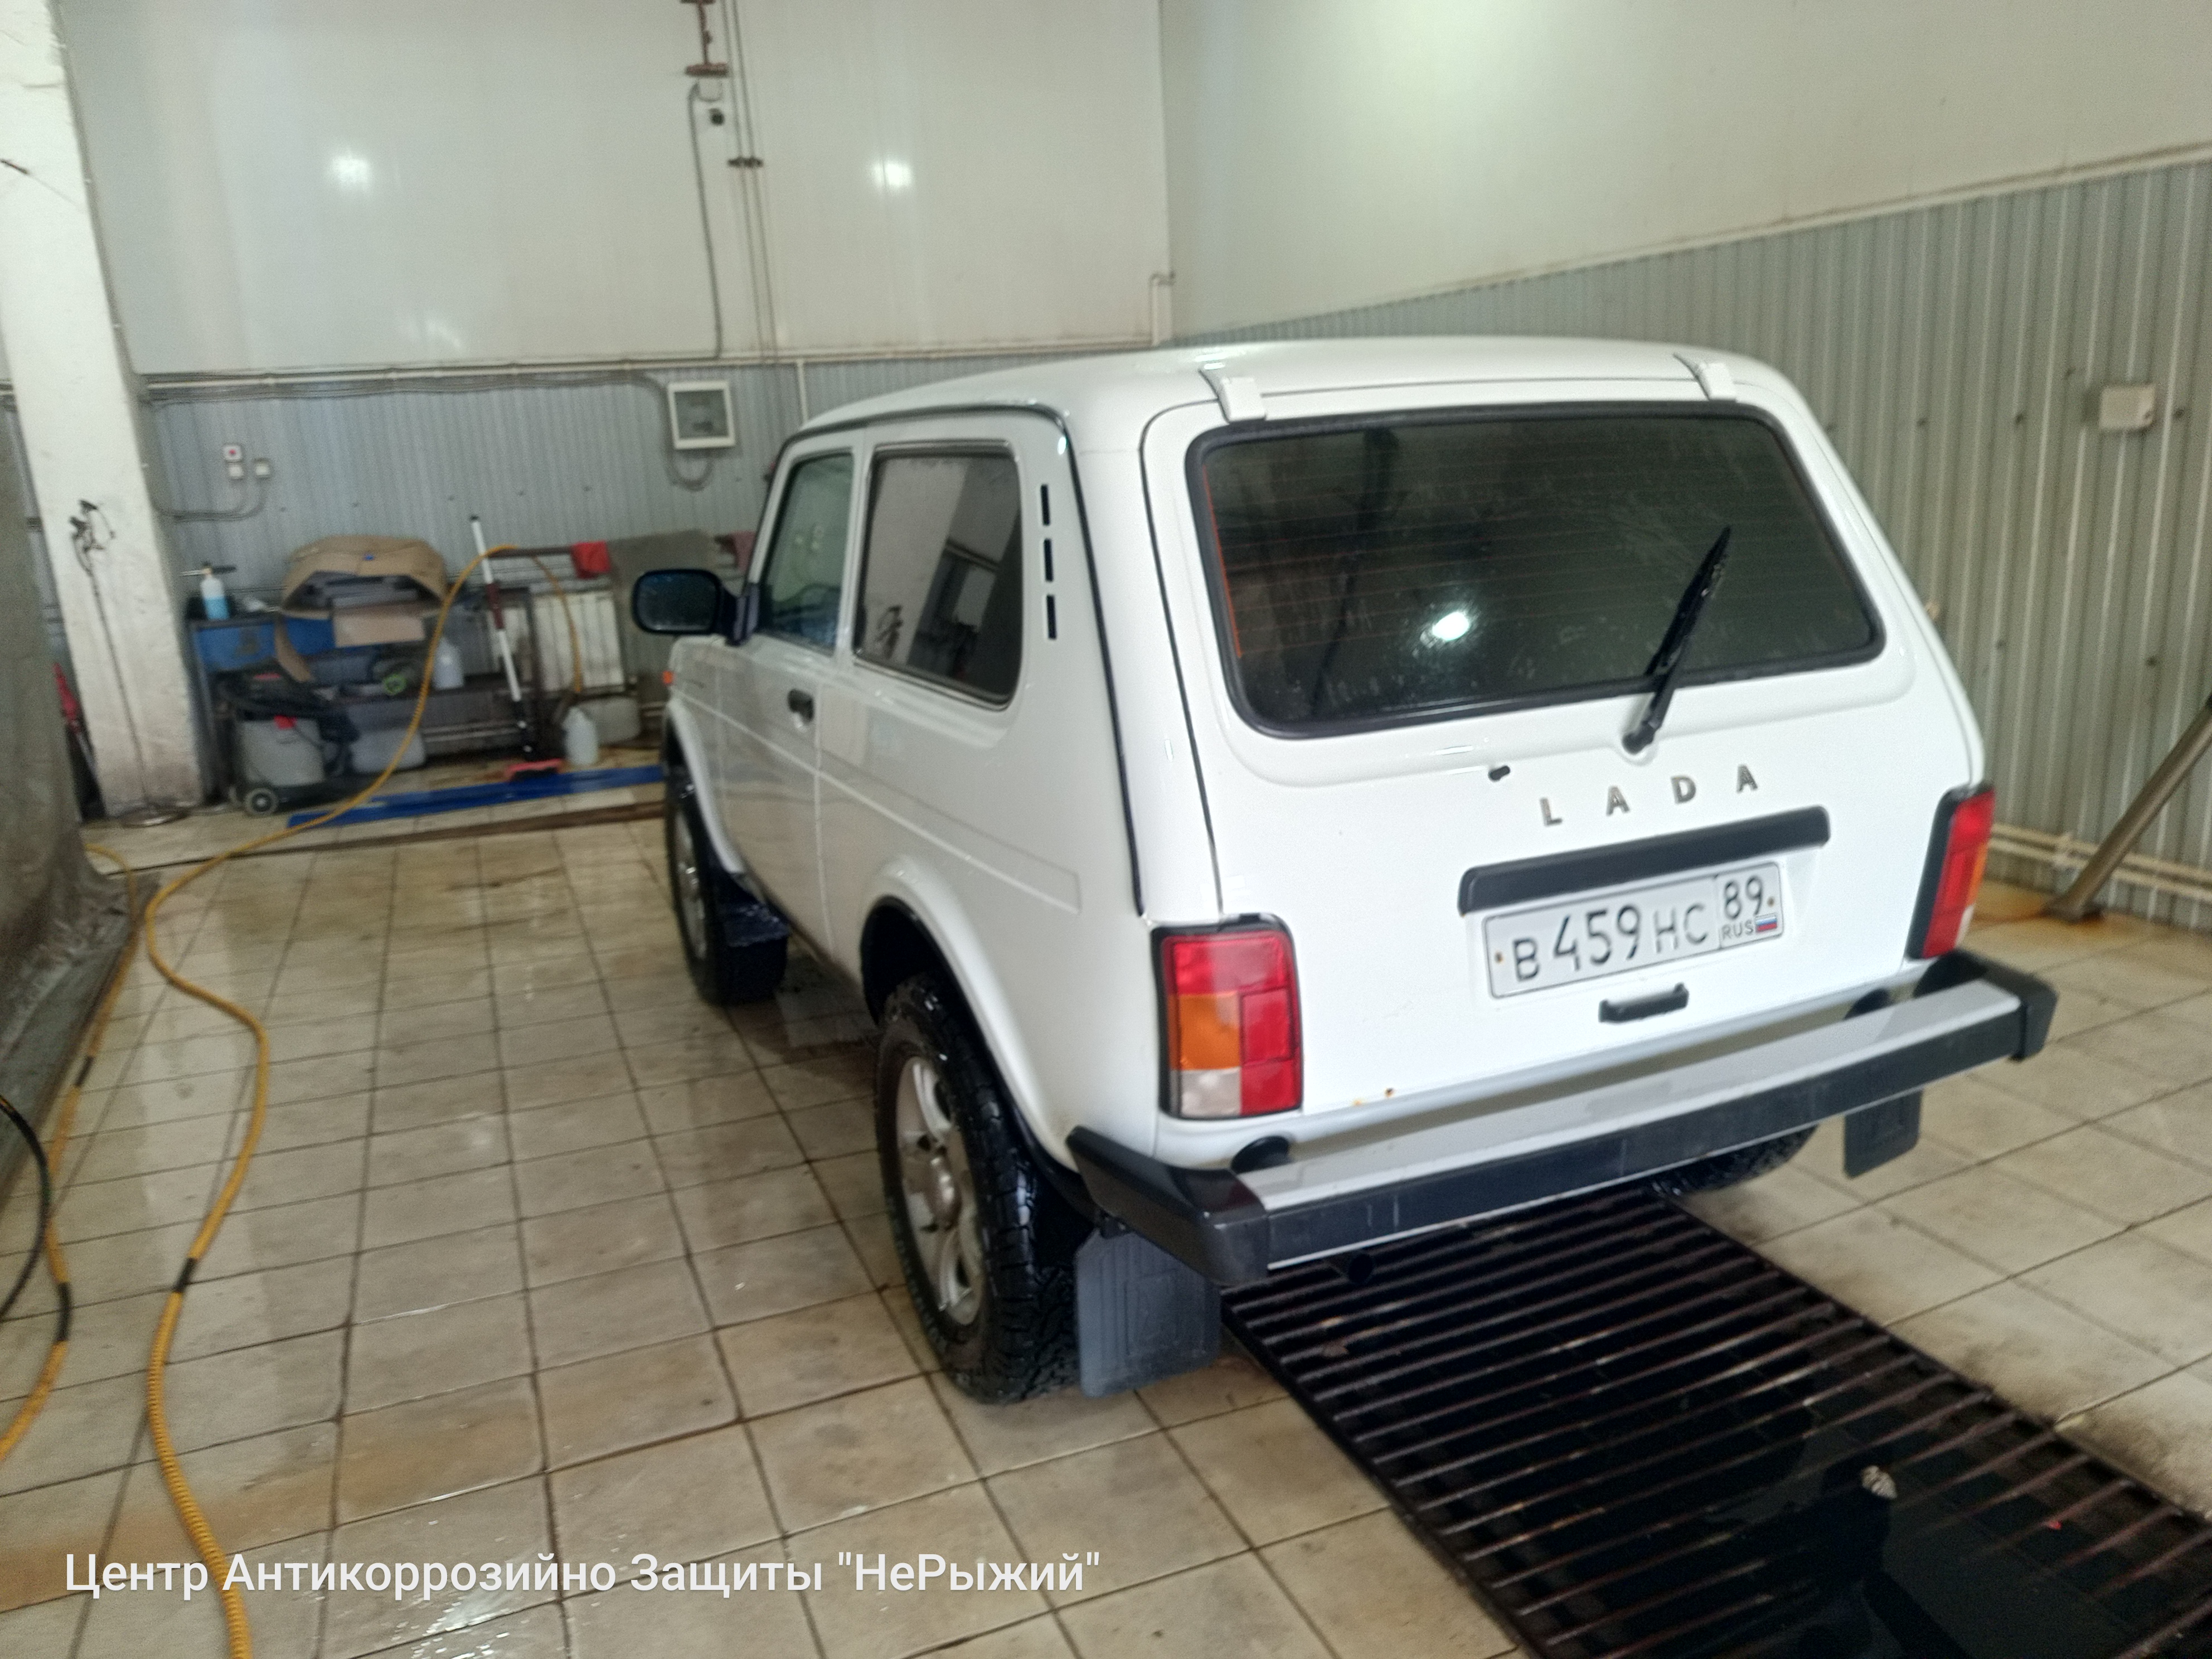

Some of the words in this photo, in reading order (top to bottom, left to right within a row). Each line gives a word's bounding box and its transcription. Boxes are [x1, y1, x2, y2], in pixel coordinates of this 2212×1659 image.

[1539, 763, 1758, 827] LADA
[1721, 875, 1764, 920] 89
[1720, 919, 1754, 940] RUS
